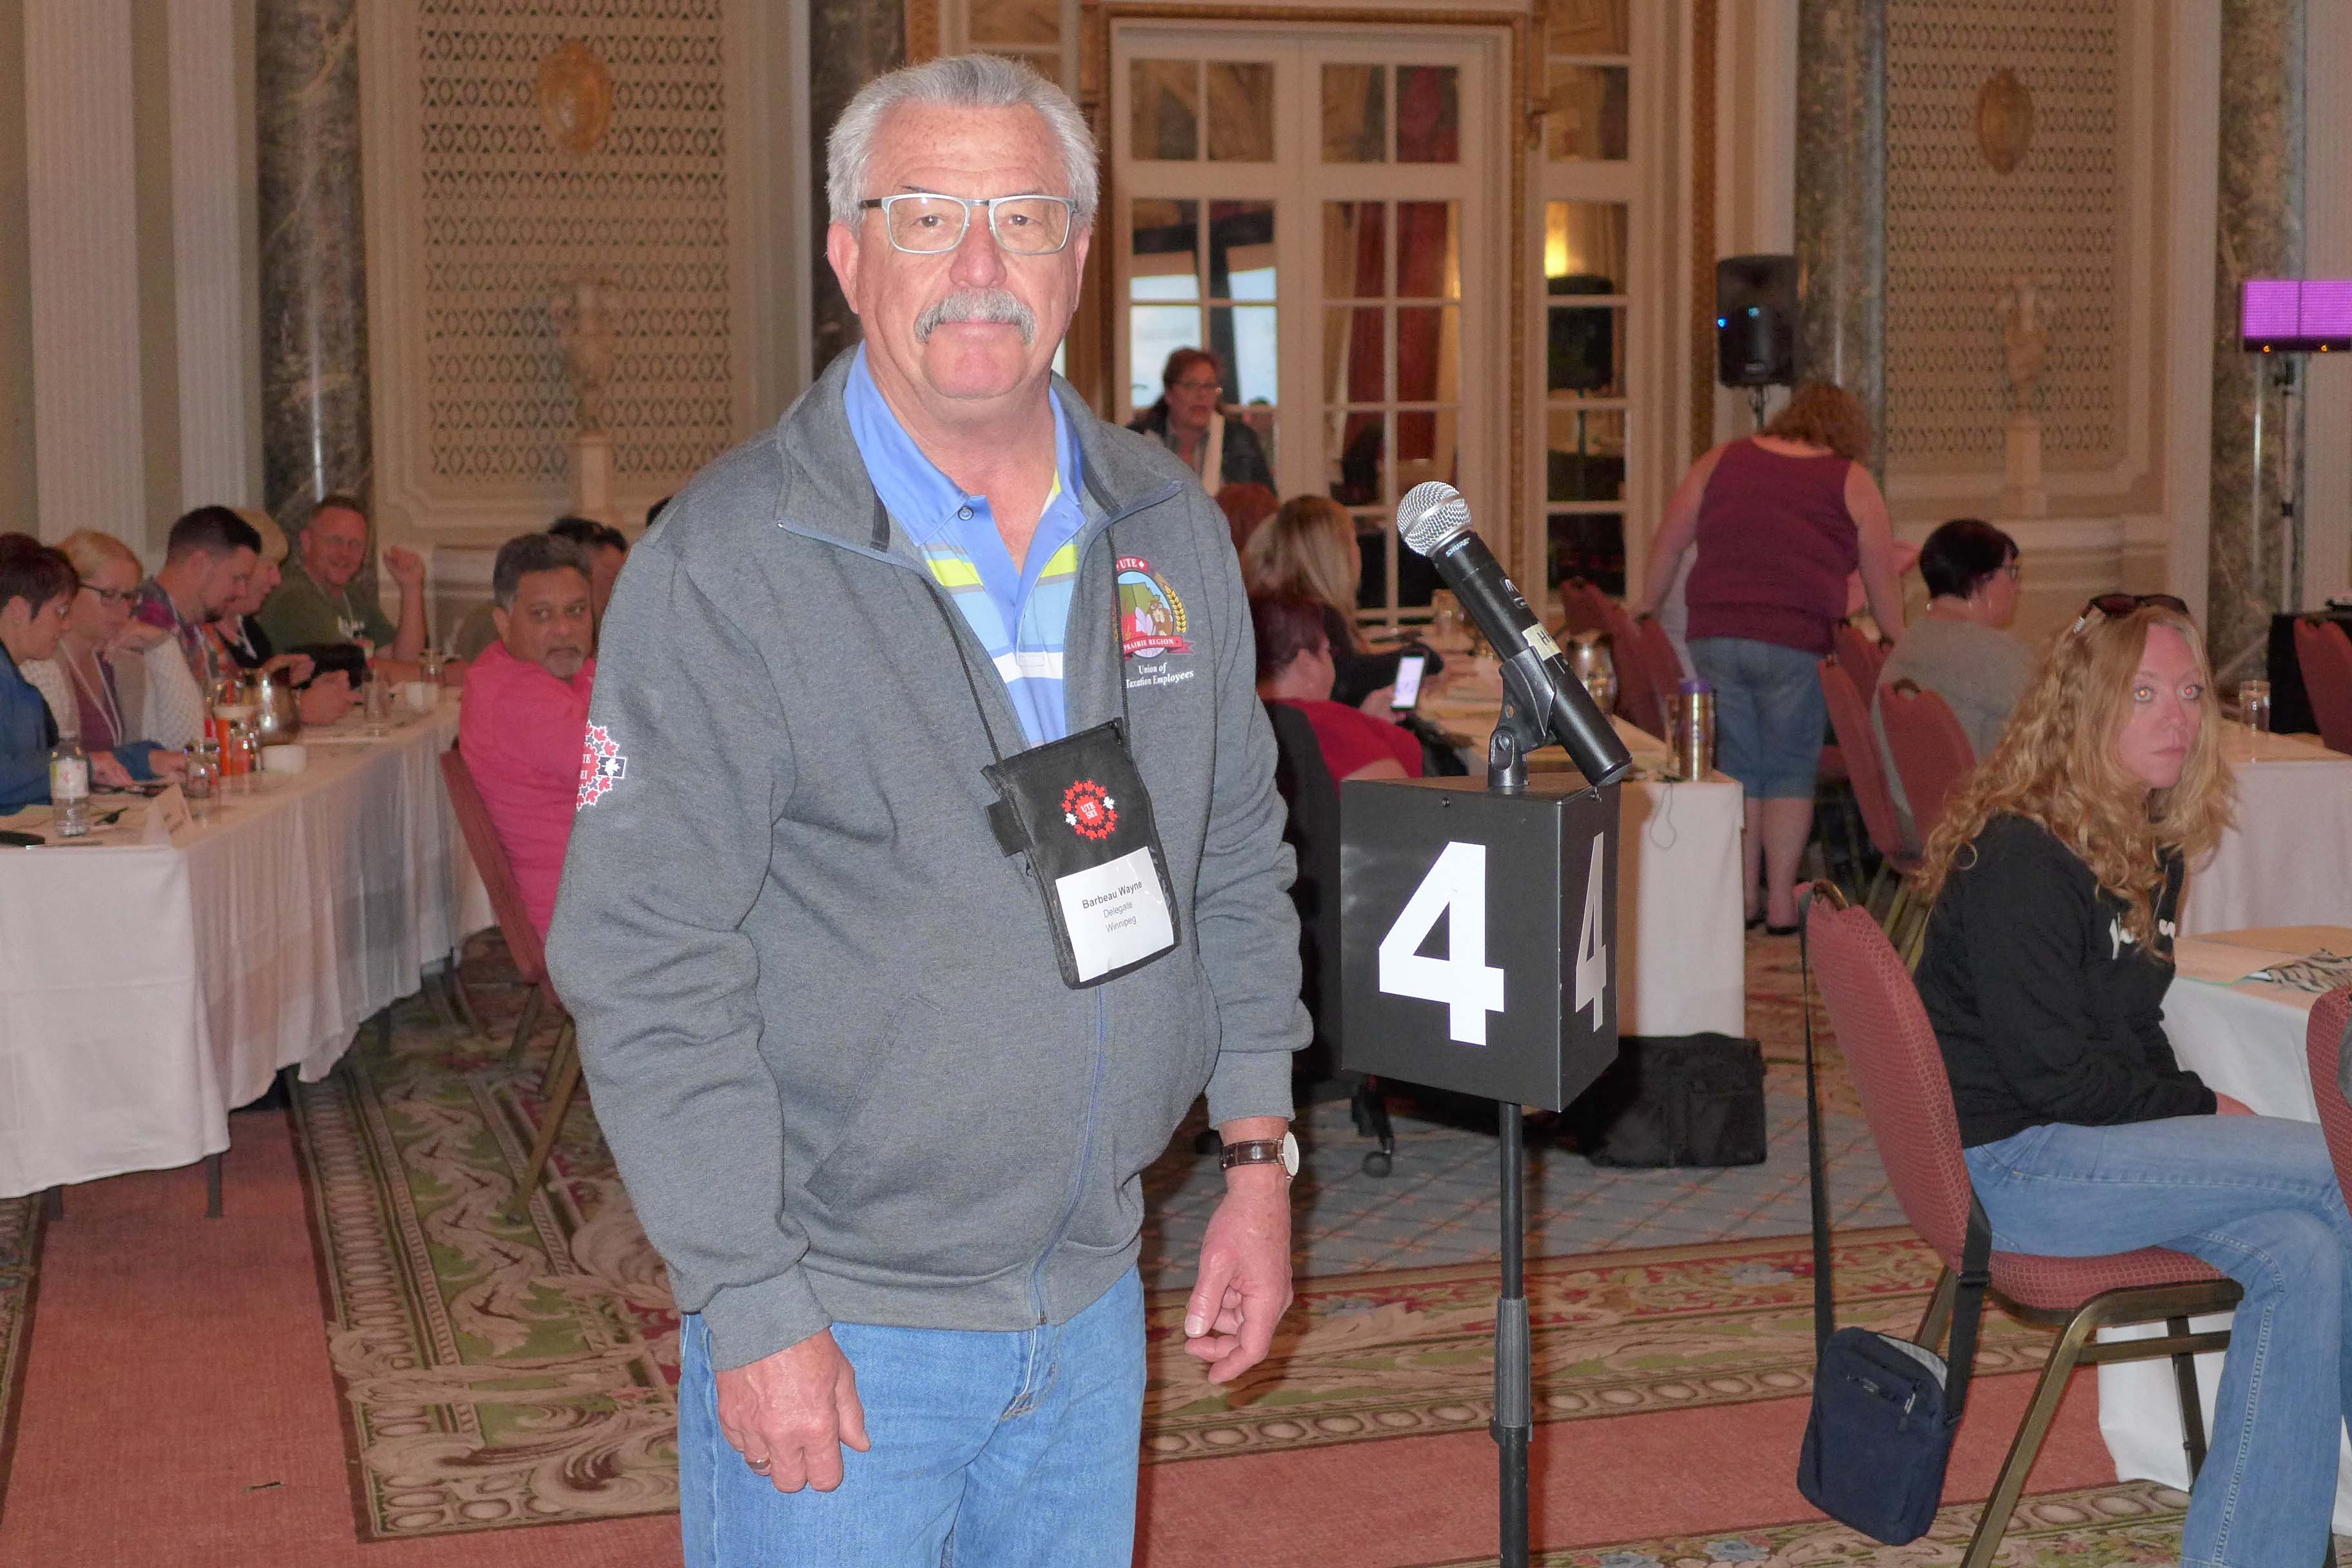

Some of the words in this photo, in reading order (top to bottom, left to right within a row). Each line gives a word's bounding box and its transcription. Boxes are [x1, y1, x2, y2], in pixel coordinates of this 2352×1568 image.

[1446, 538, 1469, 557] SHURE
[1119, 558, 1137, 569] UTE
[1123, 640, 1147, 651] PRAIRIE
[1138, 664, 1157, 674] Union
[1159, 662, 1168, 674] of
[1125, 677, 1152, 689] Taxation
[1153, 670, 1195, 686] Employees
[582, 754, 592, 763] TE
[1080, 801, 1096, 813] UTE
[1082, 892, 1117, 909] Barbeau
[1118, 881, 1142, 896] Wayne
[1103, 902, 1133, 918] Delegate
[1105, 916, 1137, 933] Winnipeg
[1576, 831, 1607, 1032] 4
[1378, 841, 1504, 1046] 4
